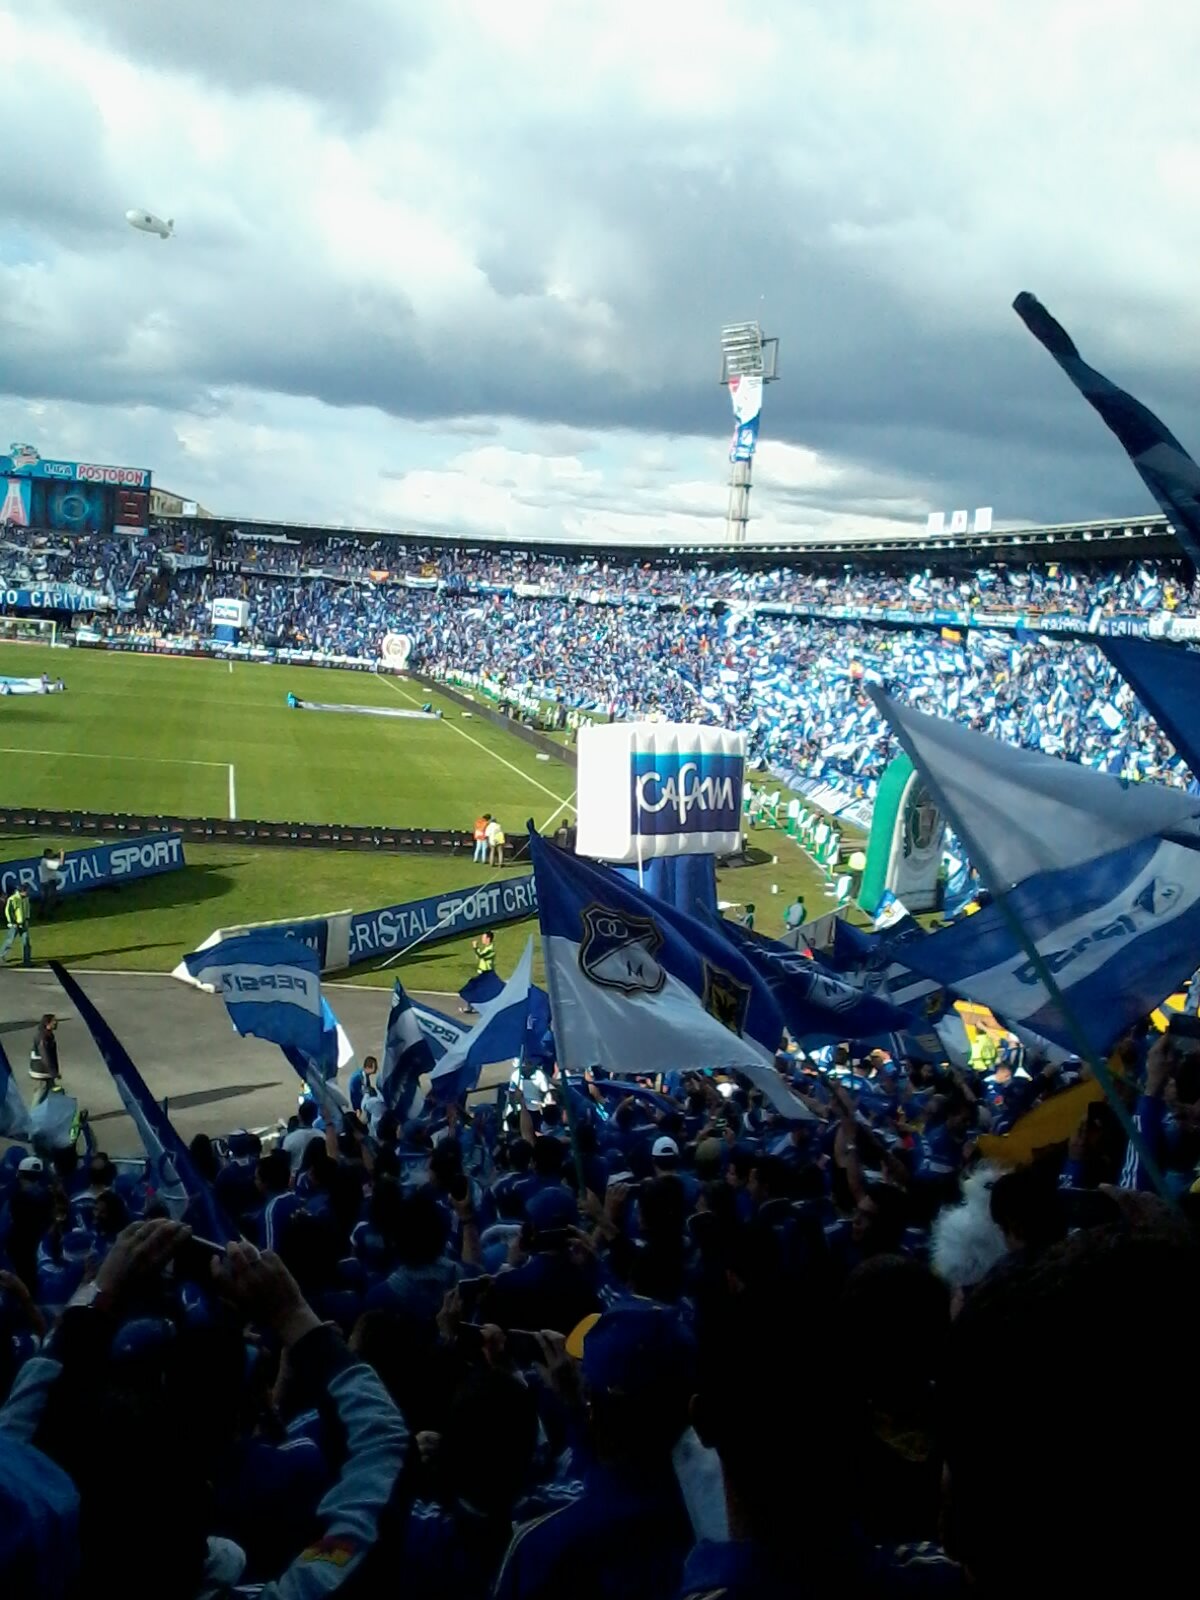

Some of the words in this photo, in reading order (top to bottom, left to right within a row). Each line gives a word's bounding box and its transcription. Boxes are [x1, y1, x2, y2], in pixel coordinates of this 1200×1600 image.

[44, 463, 73, 476] LIGA
[78, 465, 143, 484] POSTOBON
[30, 591, 96, 611] CAPITAL
[110, 838, 181, 875] SPORT
[436, 888, 500, 928] SPORT
